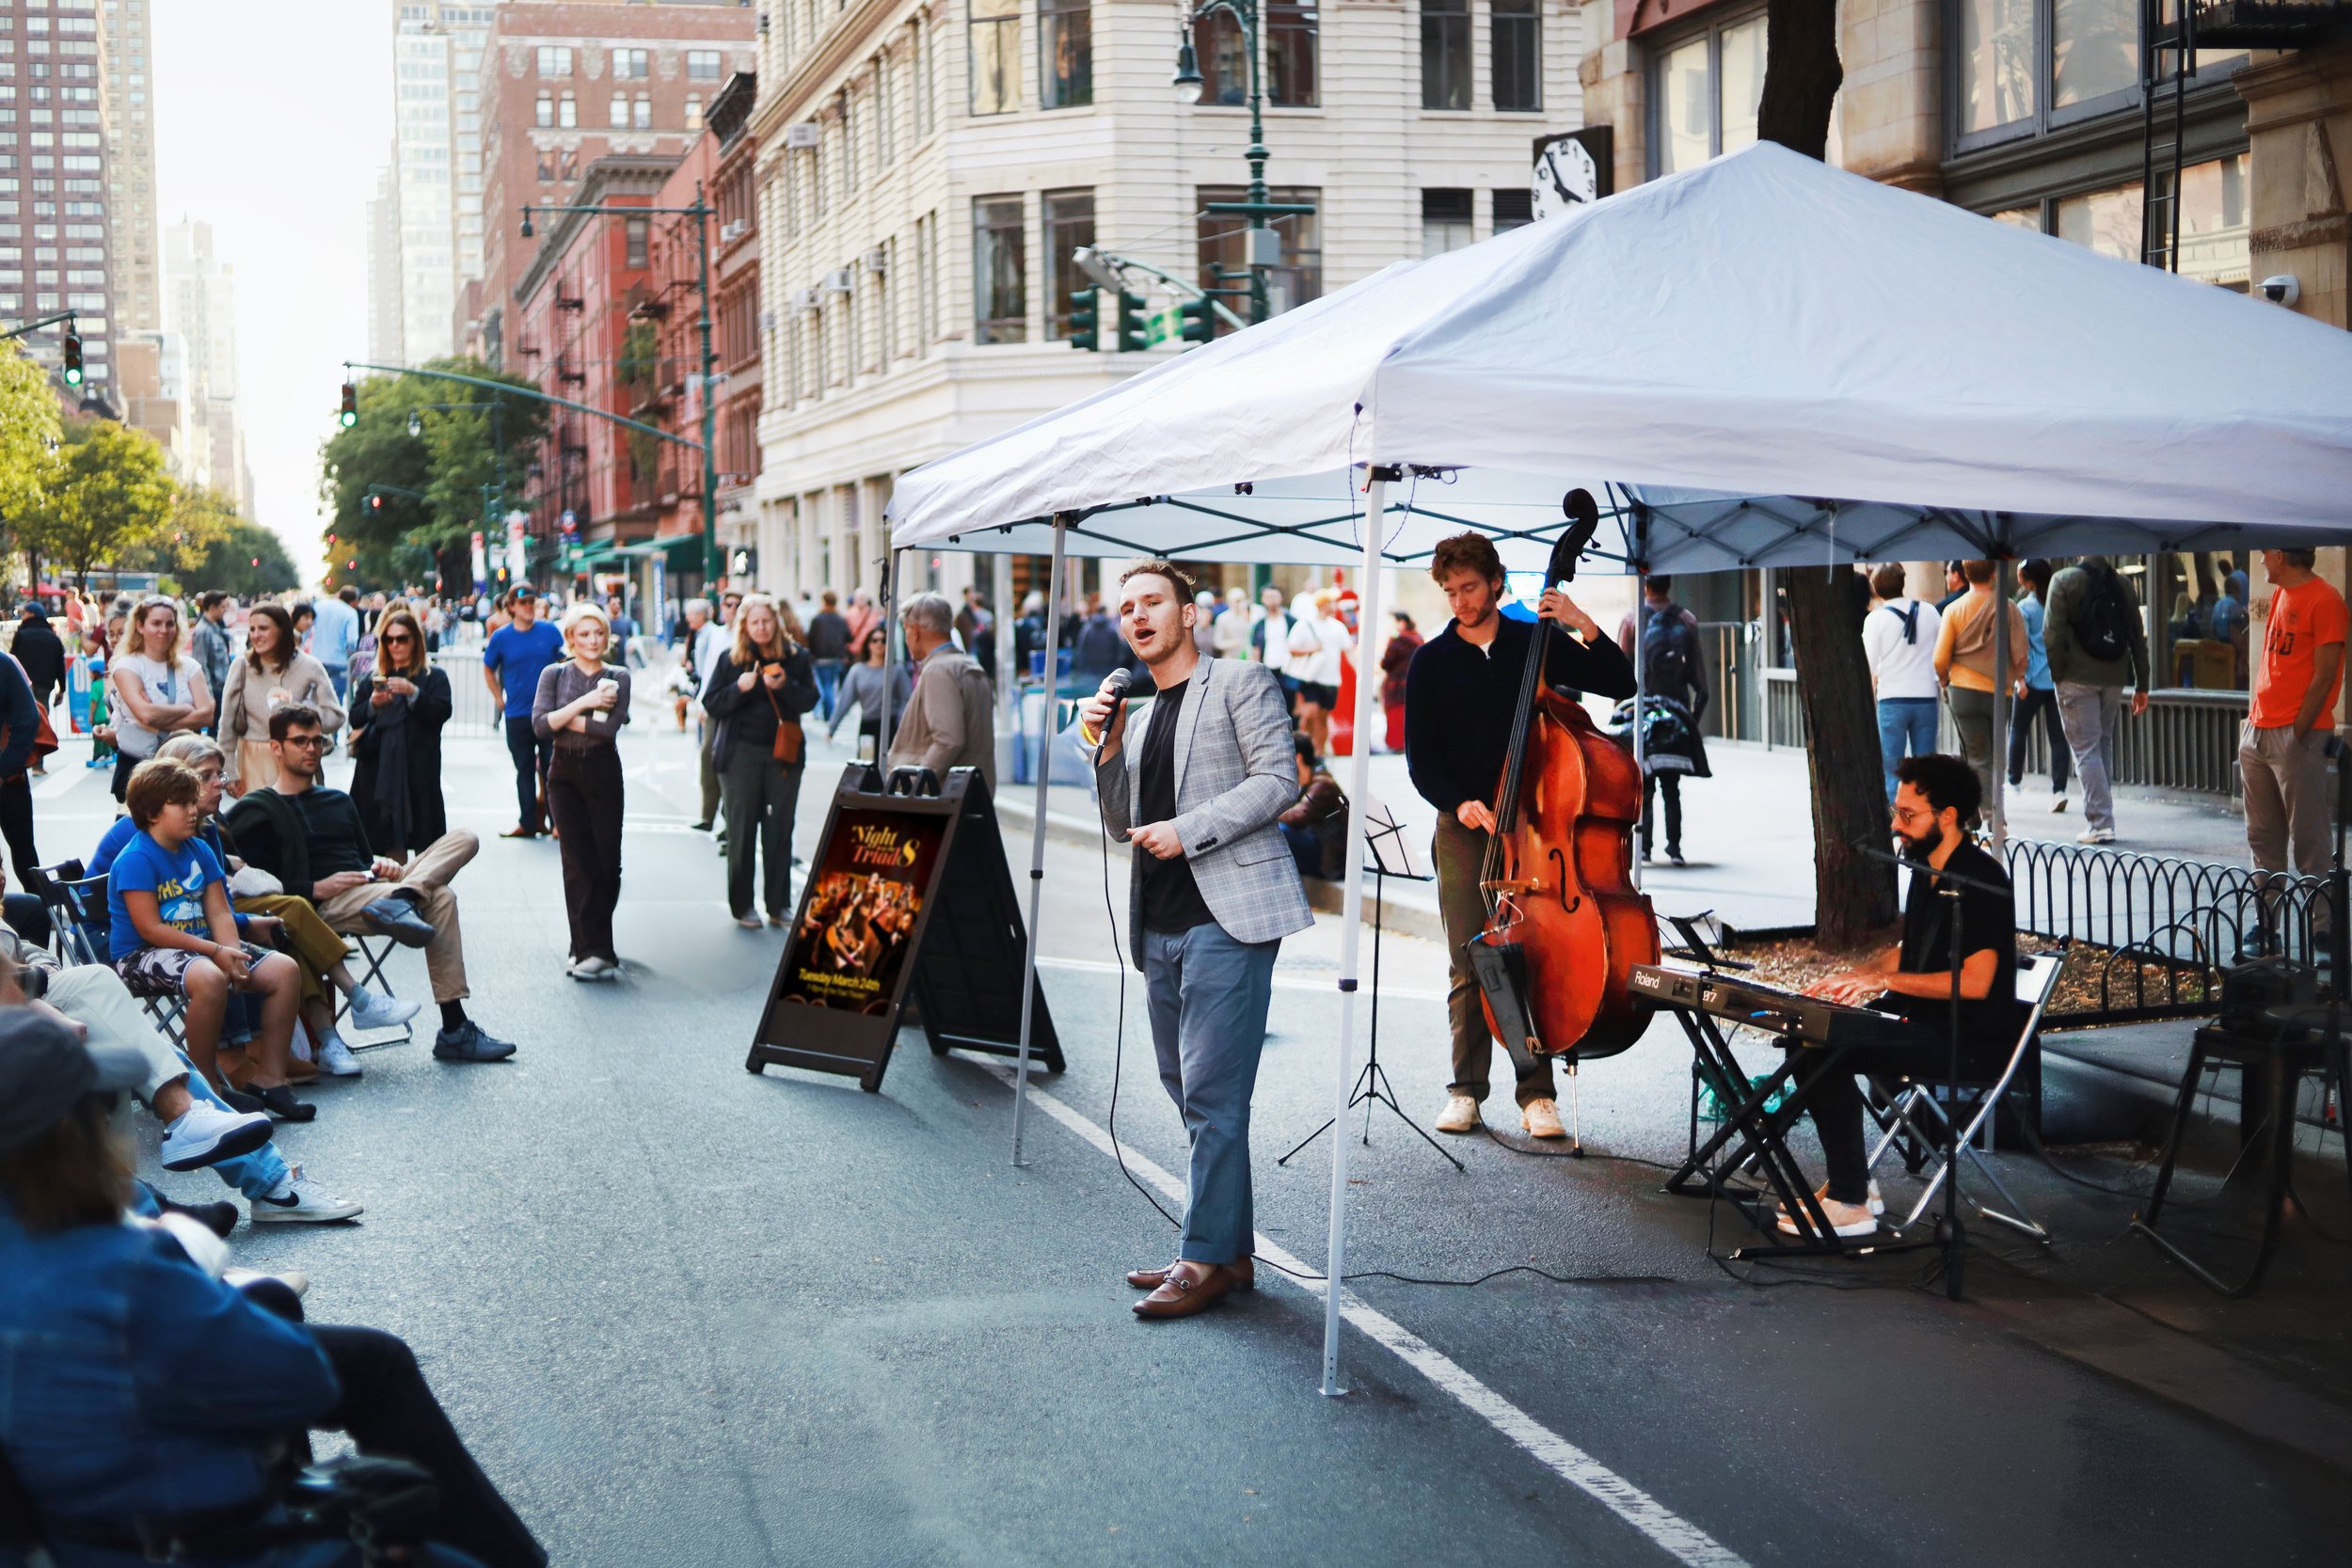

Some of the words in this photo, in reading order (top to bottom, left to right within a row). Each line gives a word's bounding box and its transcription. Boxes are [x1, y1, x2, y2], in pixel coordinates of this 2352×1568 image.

[850, 825, 898, 848] Night
[852, 845, 901, 865] Triad
[897, 839, 920, 867] 8
[832, 974, 860, 990] March
[1634, 971, 1661, 990] Roland
